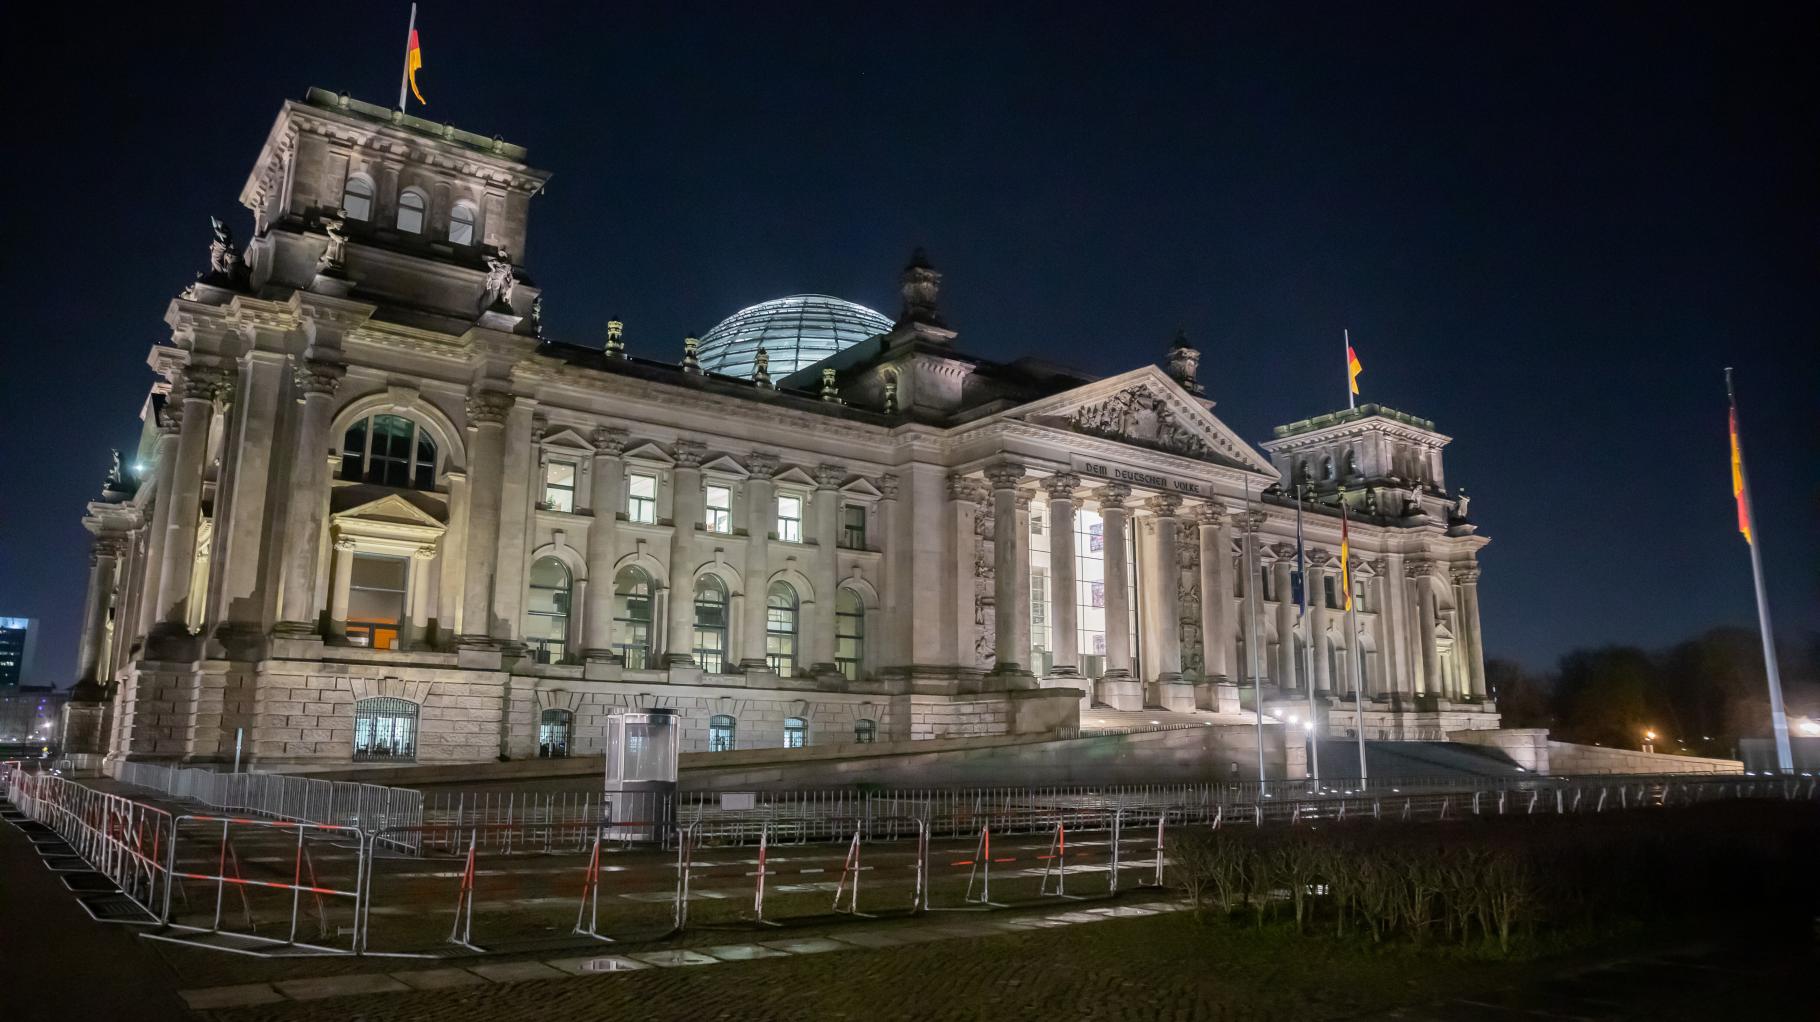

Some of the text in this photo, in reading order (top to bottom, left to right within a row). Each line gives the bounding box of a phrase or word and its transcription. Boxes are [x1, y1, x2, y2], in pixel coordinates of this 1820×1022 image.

[1086, 462, 1200, 493] DEM DEUTSCHEN VOLKE
